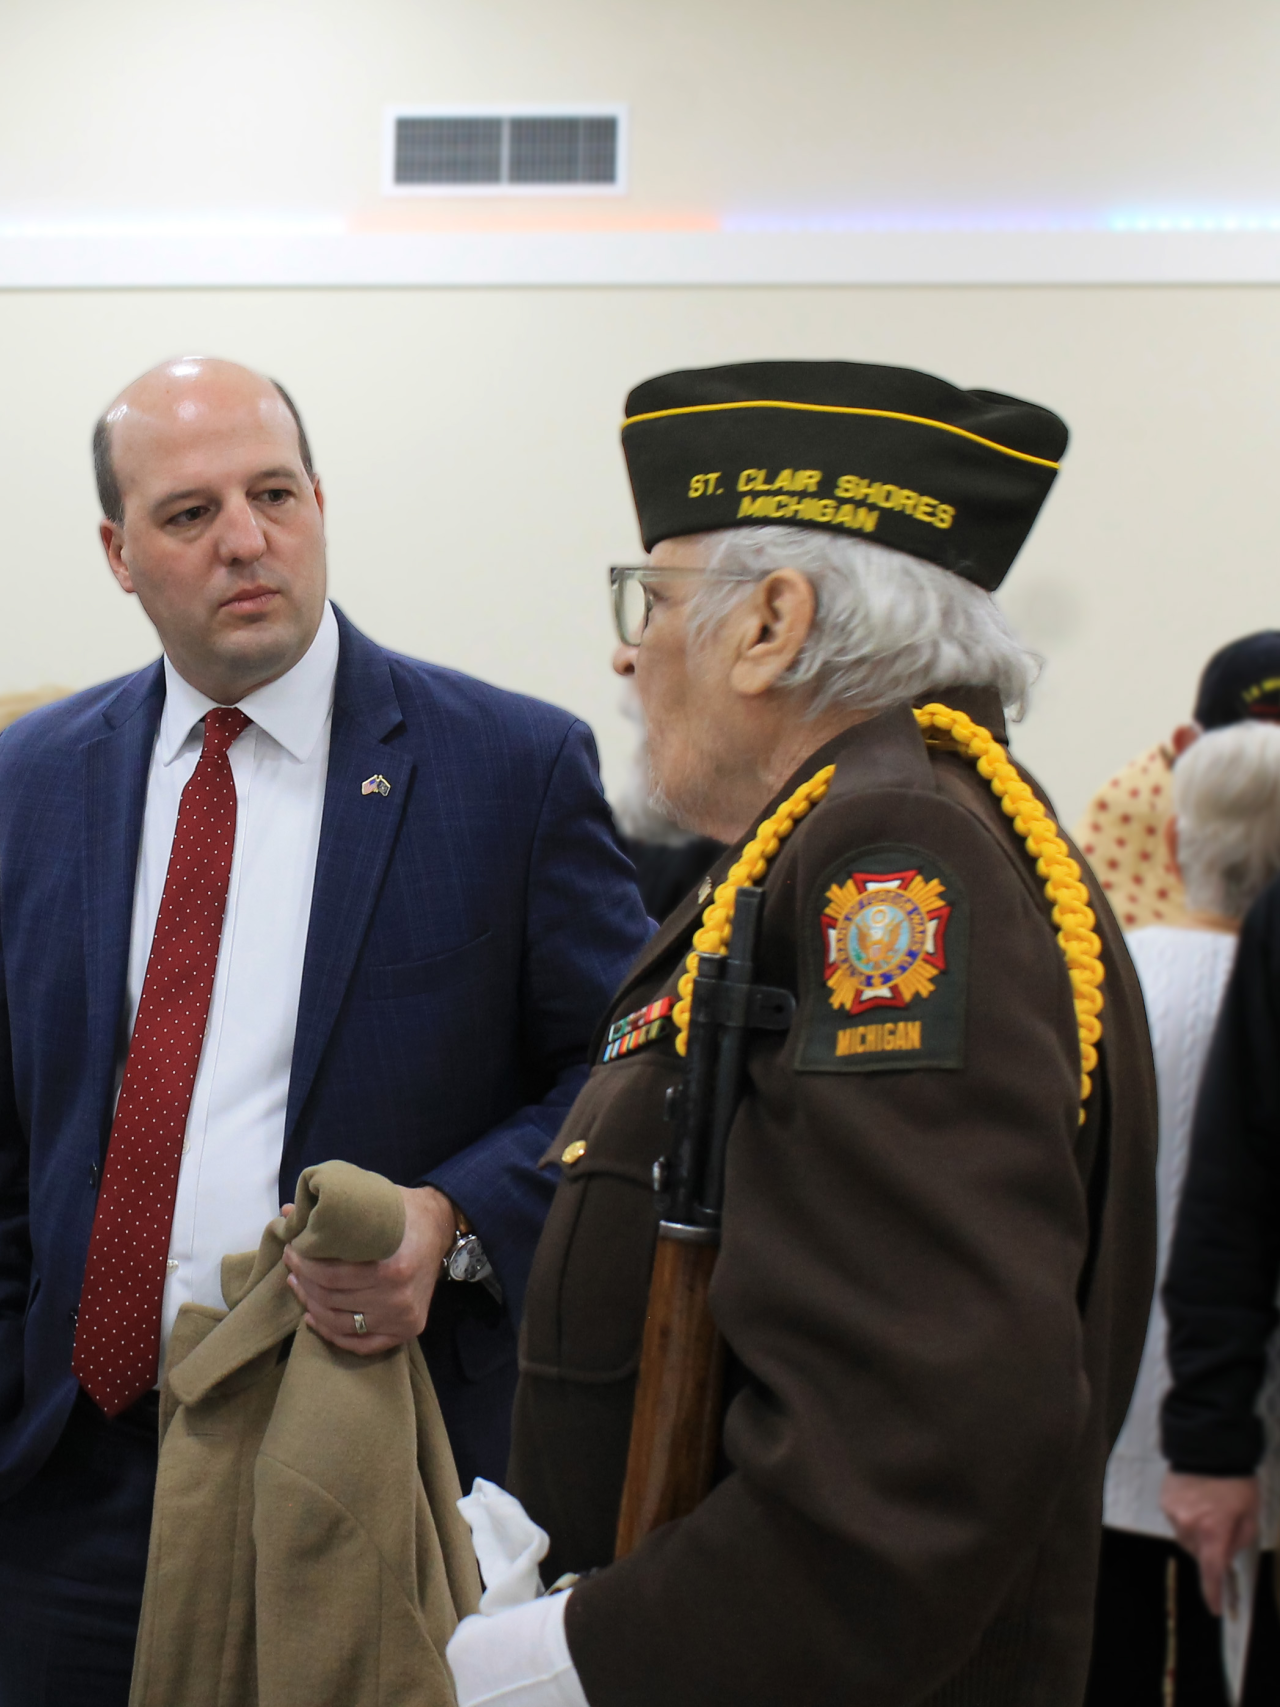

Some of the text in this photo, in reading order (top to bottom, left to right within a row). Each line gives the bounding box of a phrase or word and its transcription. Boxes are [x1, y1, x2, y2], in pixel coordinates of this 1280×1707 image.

[687, 468, 956, 529] ST. CLAIR SHORES
[737, 495, 880, 532] MICHIGAN
[835, 1021, 922, 1056] MICHIGAN
